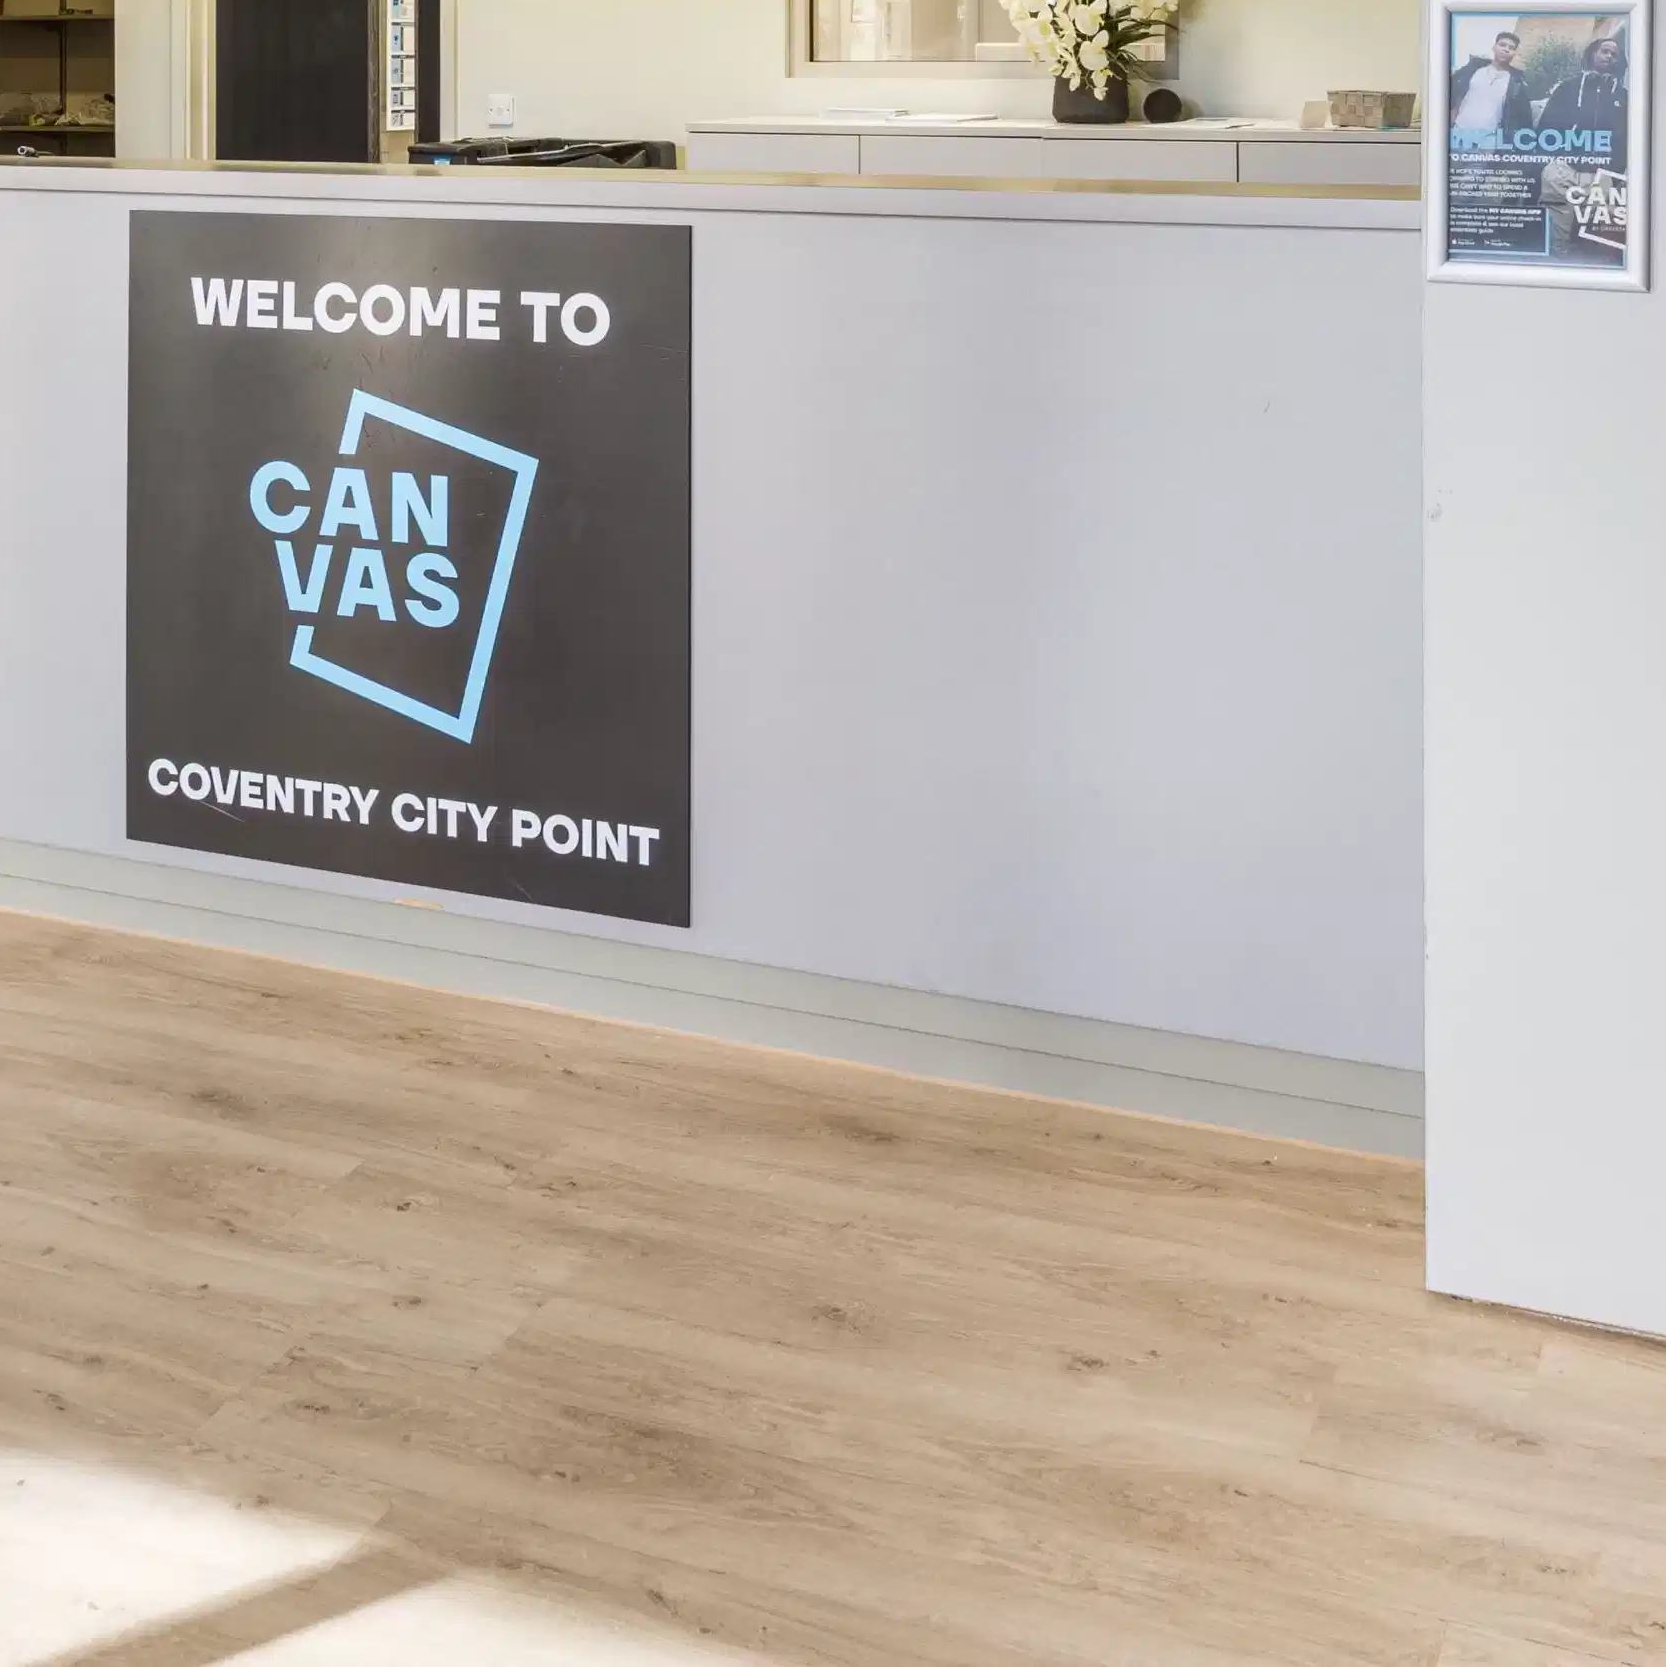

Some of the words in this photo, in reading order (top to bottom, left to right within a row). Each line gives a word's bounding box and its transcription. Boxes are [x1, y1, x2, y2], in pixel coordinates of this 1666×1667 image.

[1450, 128, 1613, 152] WELCOME
[1460, 154, 1500, 163] CANVAS
[1502, 155, 1553, 164] COVENTRY
[1556, 156, 1578, 164] CITY
[1581, 156, 1612, 164] POINT
[1566, 186, 1627, 206] CAN
[1574, 204, 1627, 225] VAS
[191, 277, 501, 341] WELCOME
[520, 291, 611, 347] TO
[249, 461, 450, 546] CAN
[273, 539, 460, 628] VAS
[147, 758, 379, 825] COVENTRY
[392, 792, 498, 843] CITY
[511, 808, 660, 867] POINT
